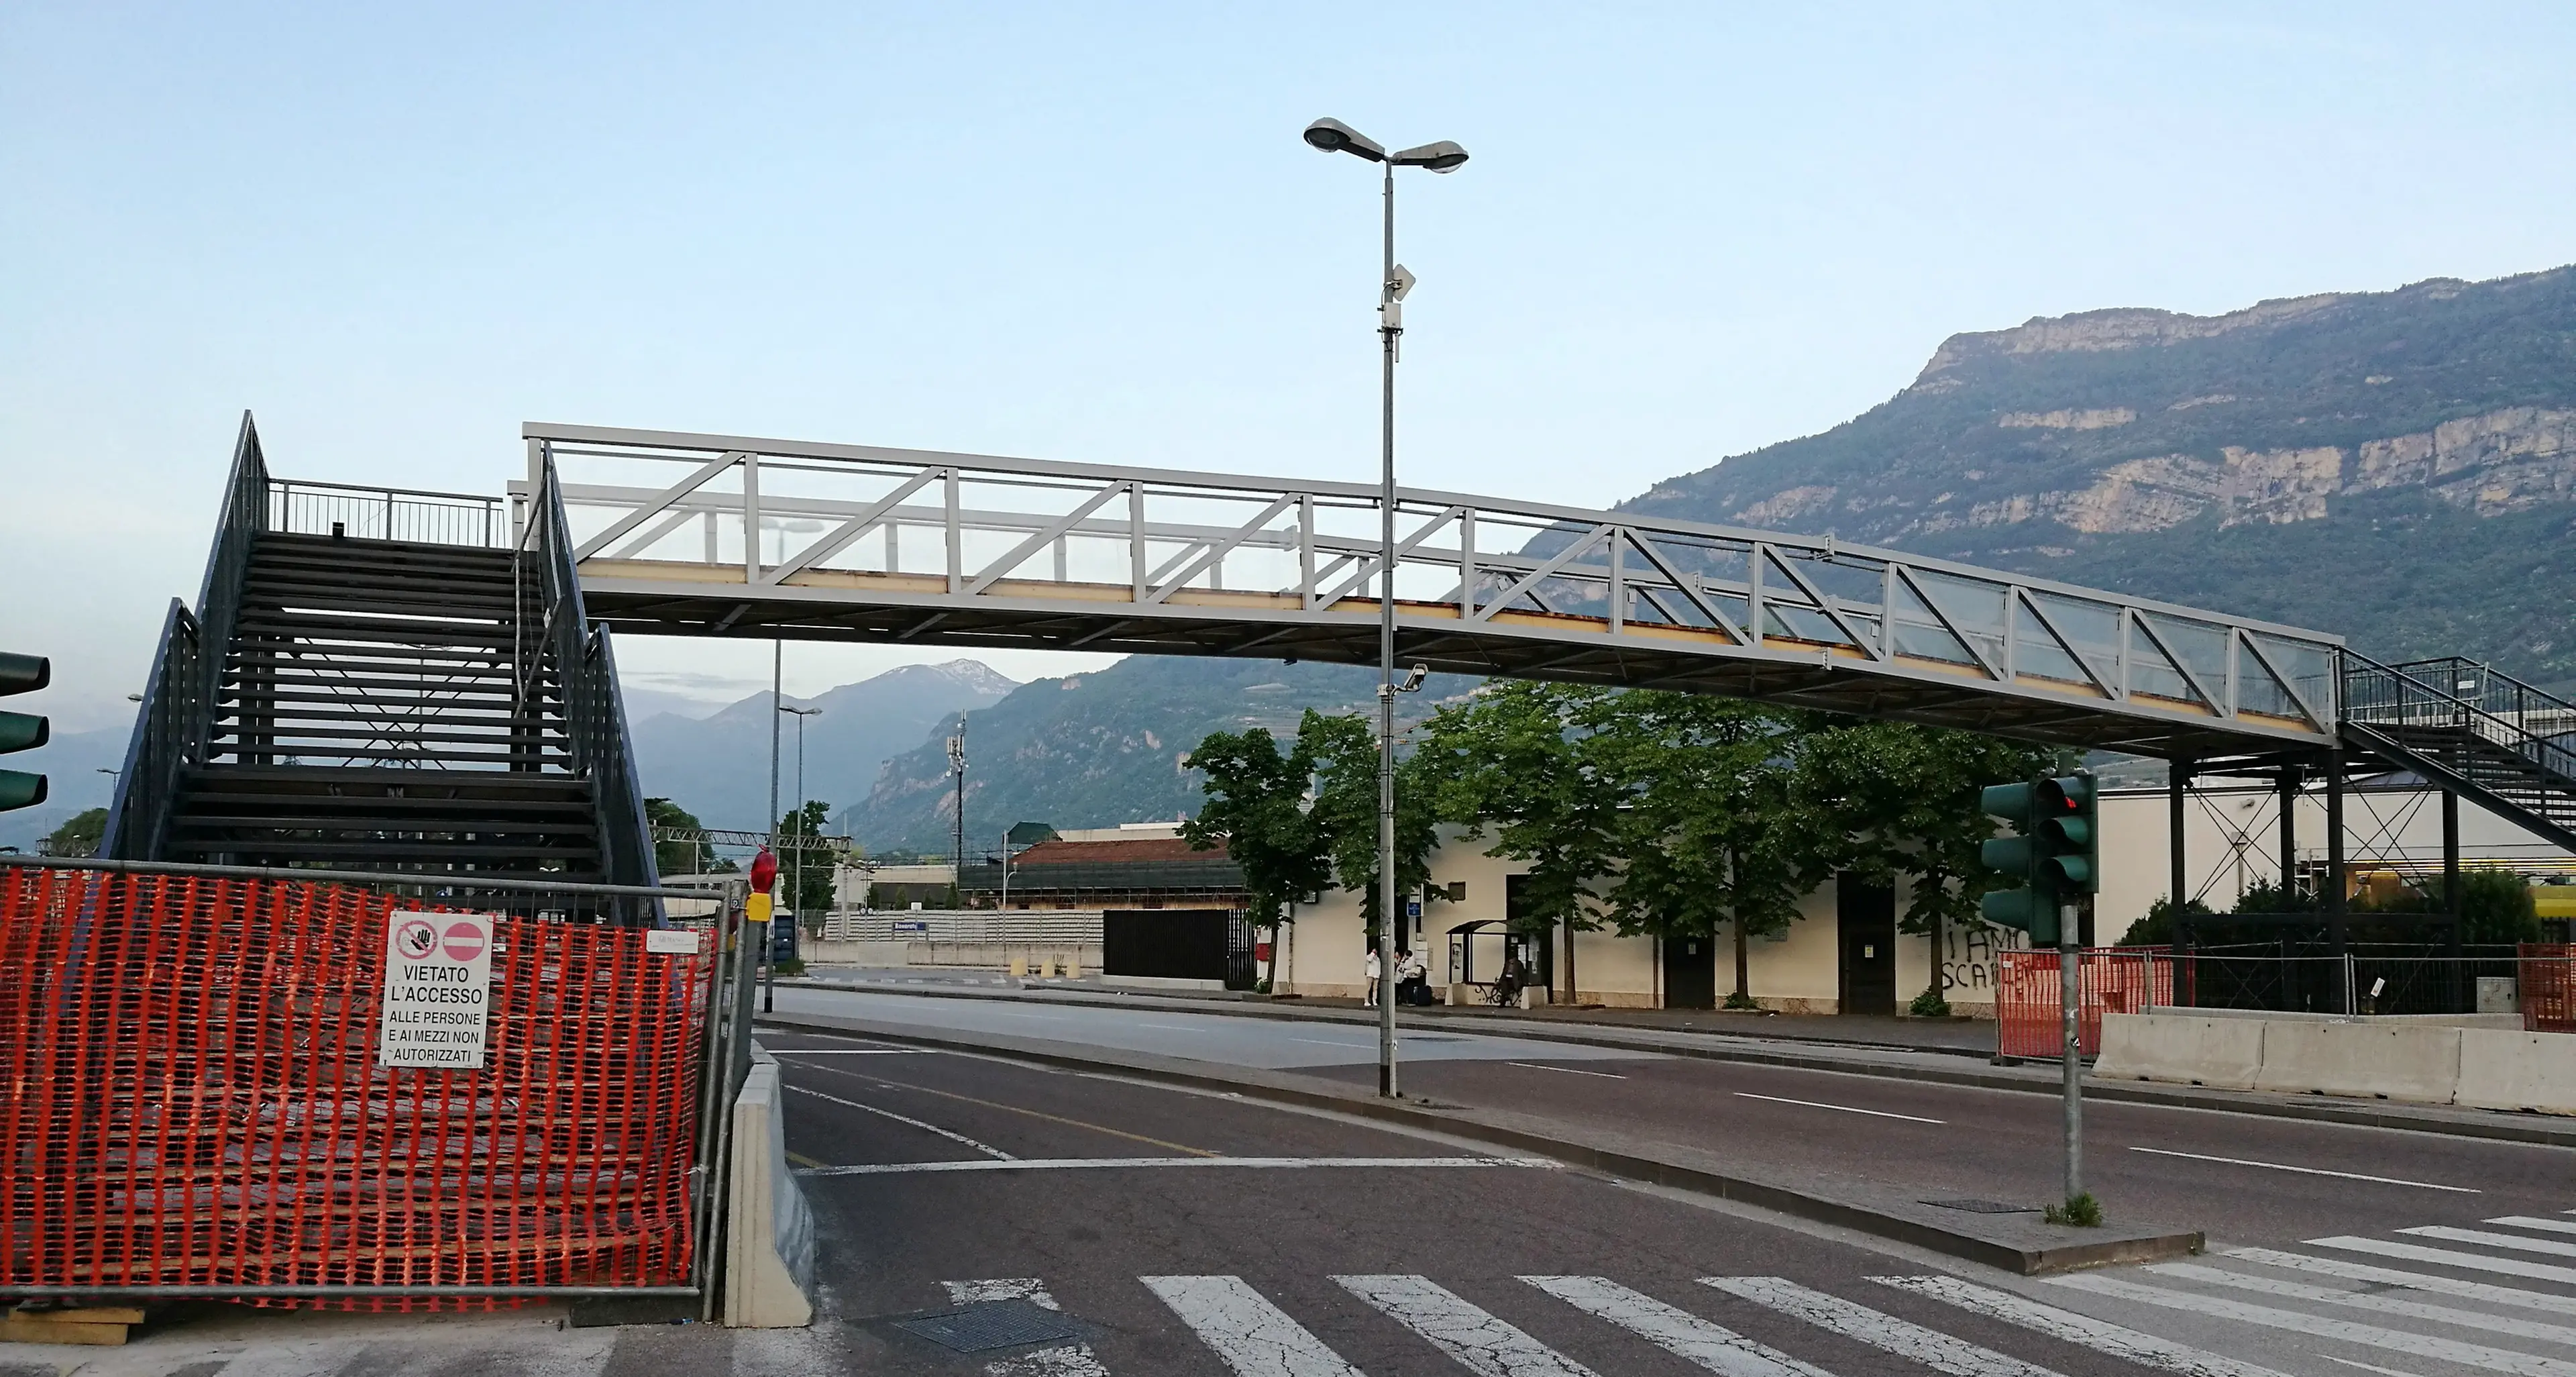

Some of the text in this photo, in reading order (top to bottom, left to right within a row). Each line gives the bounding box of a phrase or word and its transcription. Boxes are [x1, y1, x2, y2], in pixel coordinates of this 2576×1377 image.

[405, 965, 468, 982] VIETATO
[391, 986, 482, 1004] L'ACCESSO
[390, 1011, 480, 1025] ALLE PERSONE
[389, 1029, 479, 1044] E AI MEZZI NON
[394, 1049, 471, 1062] AUTORIZZATI
